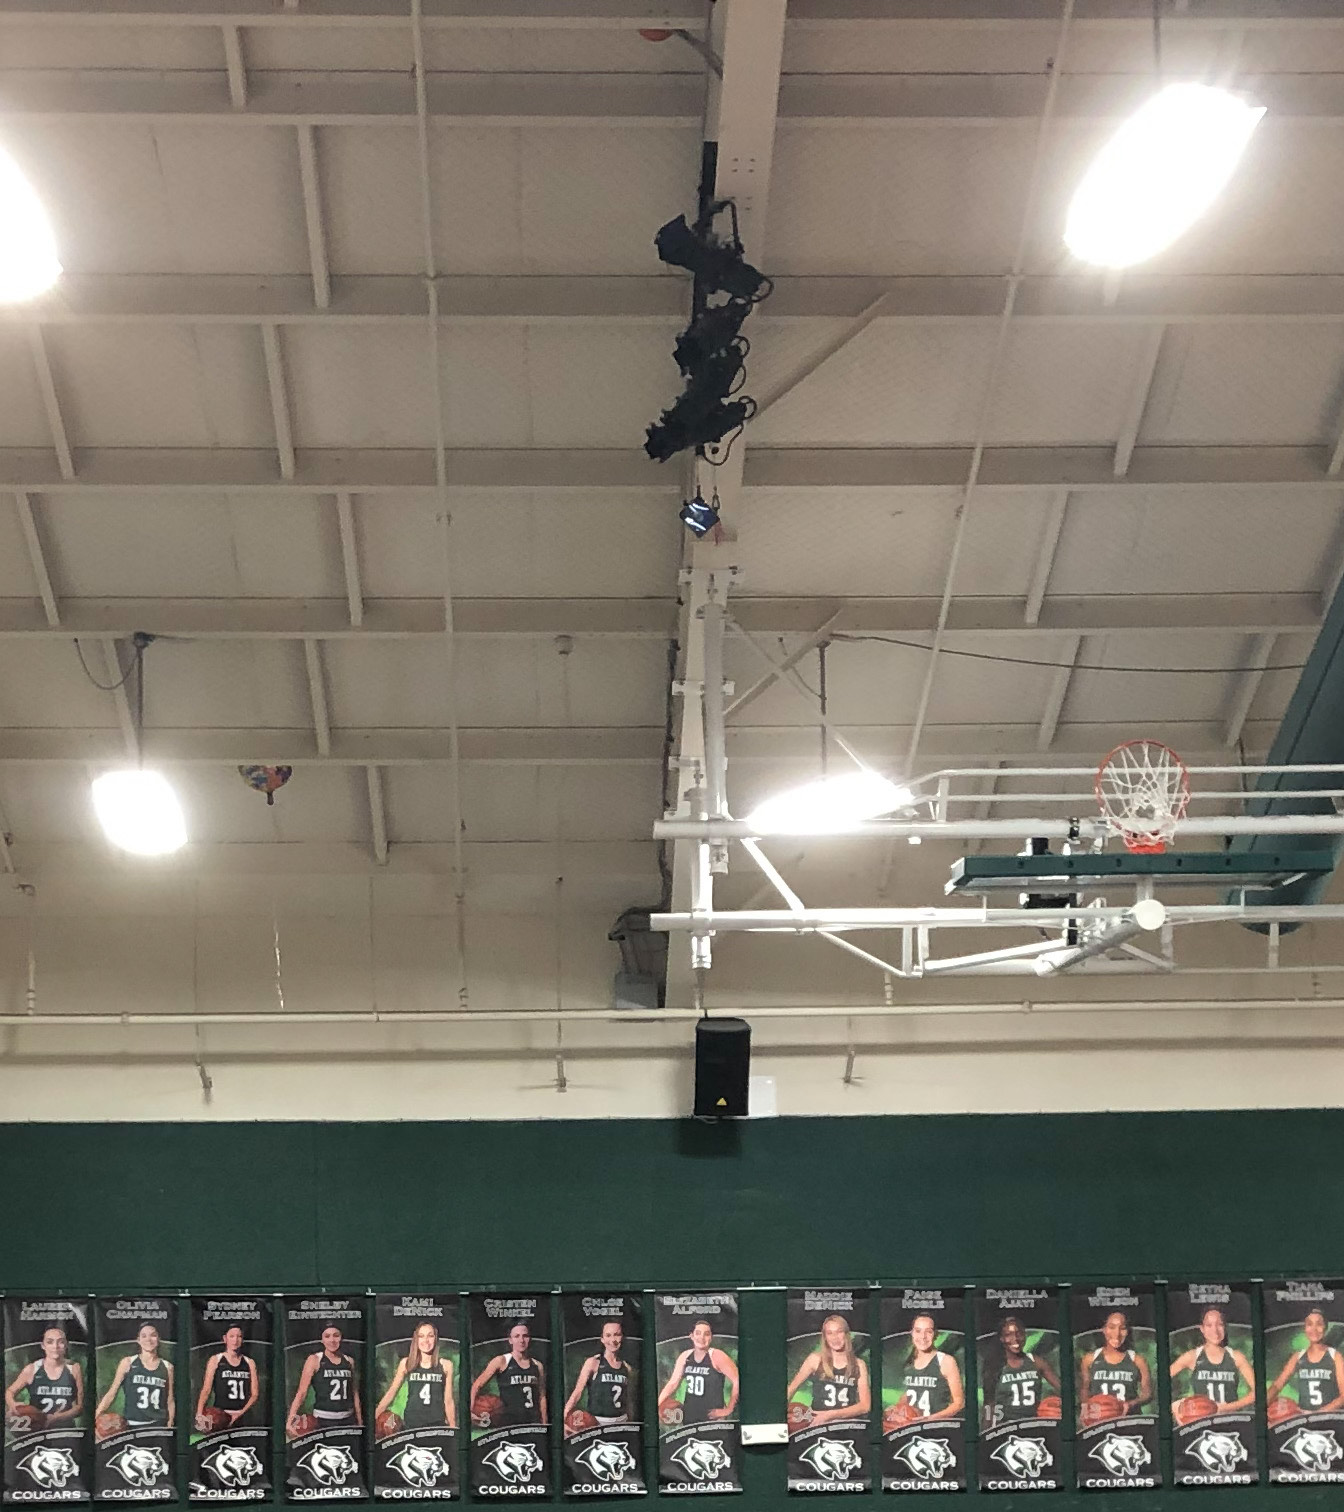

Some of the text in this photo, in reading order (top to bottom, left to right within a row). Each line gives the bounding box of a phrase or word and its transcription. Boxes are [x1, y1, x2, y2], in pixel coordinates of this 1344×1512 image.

[221, 1370, 251, 1380] ATLANTIC
[409, 1372, 443, 1383] ATLANTIC
[1001, 1370, 1038, 1384] ATLANTIC
[1093, 1370, 1134, 1382] ATLANTIC
[1197, 1369, 1236, 1381] ATLANTIC
[1299, 1369, 1333, 1380] ATLANTIC
[132, 1374, 167, 1388] ATLANTIC
[686, 1375, 705, 1396] 30
[36, 1385, 73, 1396] ATLANTIC
[227, 1380, 246, 1400] 31
[329, 1379, 349, 1401] 21
[419, 1383, 432, 1404] 4
[824, 1384, 850, 1408] 34
[1011, 1381, 1036, 1407] 15
[1308, 1381, 1323, 1406] 5
[136, 1387, 161, 1410] 34
[522, 1386, 534, 1409] 3
[611, 1386, 623, 1408] 2
[663, 1408, 684, 1425] 30
[984, 1404, 1005, 1422] 15
[8, 1415, 33, 1433] 22
[480, 1411, 492, 1429] 3
[889, 1480, 960, 1491] COUGARS
[987, 1480, 1057, 1491] COUGARS
[1086, 1478, 1155, 1489] COUGARS
[1182, 1474, 1252, 1485] COUGARS
[293, 1486, 362, 1498] COUGARS
[479, 1484, 546, 1495] COUGARS
[571, 1483, 638, 1493] COUGARS
[667, 1481, 734, 1492] COUGARS
[796, 1481, 865, 1492] COUGARS
[12, 1490, 82, 1501] COUGARS
[101, 1488, 171, 1500] COUGARS
[197, 1488, 265, 1499] COUGARS
[381, 1488, 452, 1500] COUGARS
